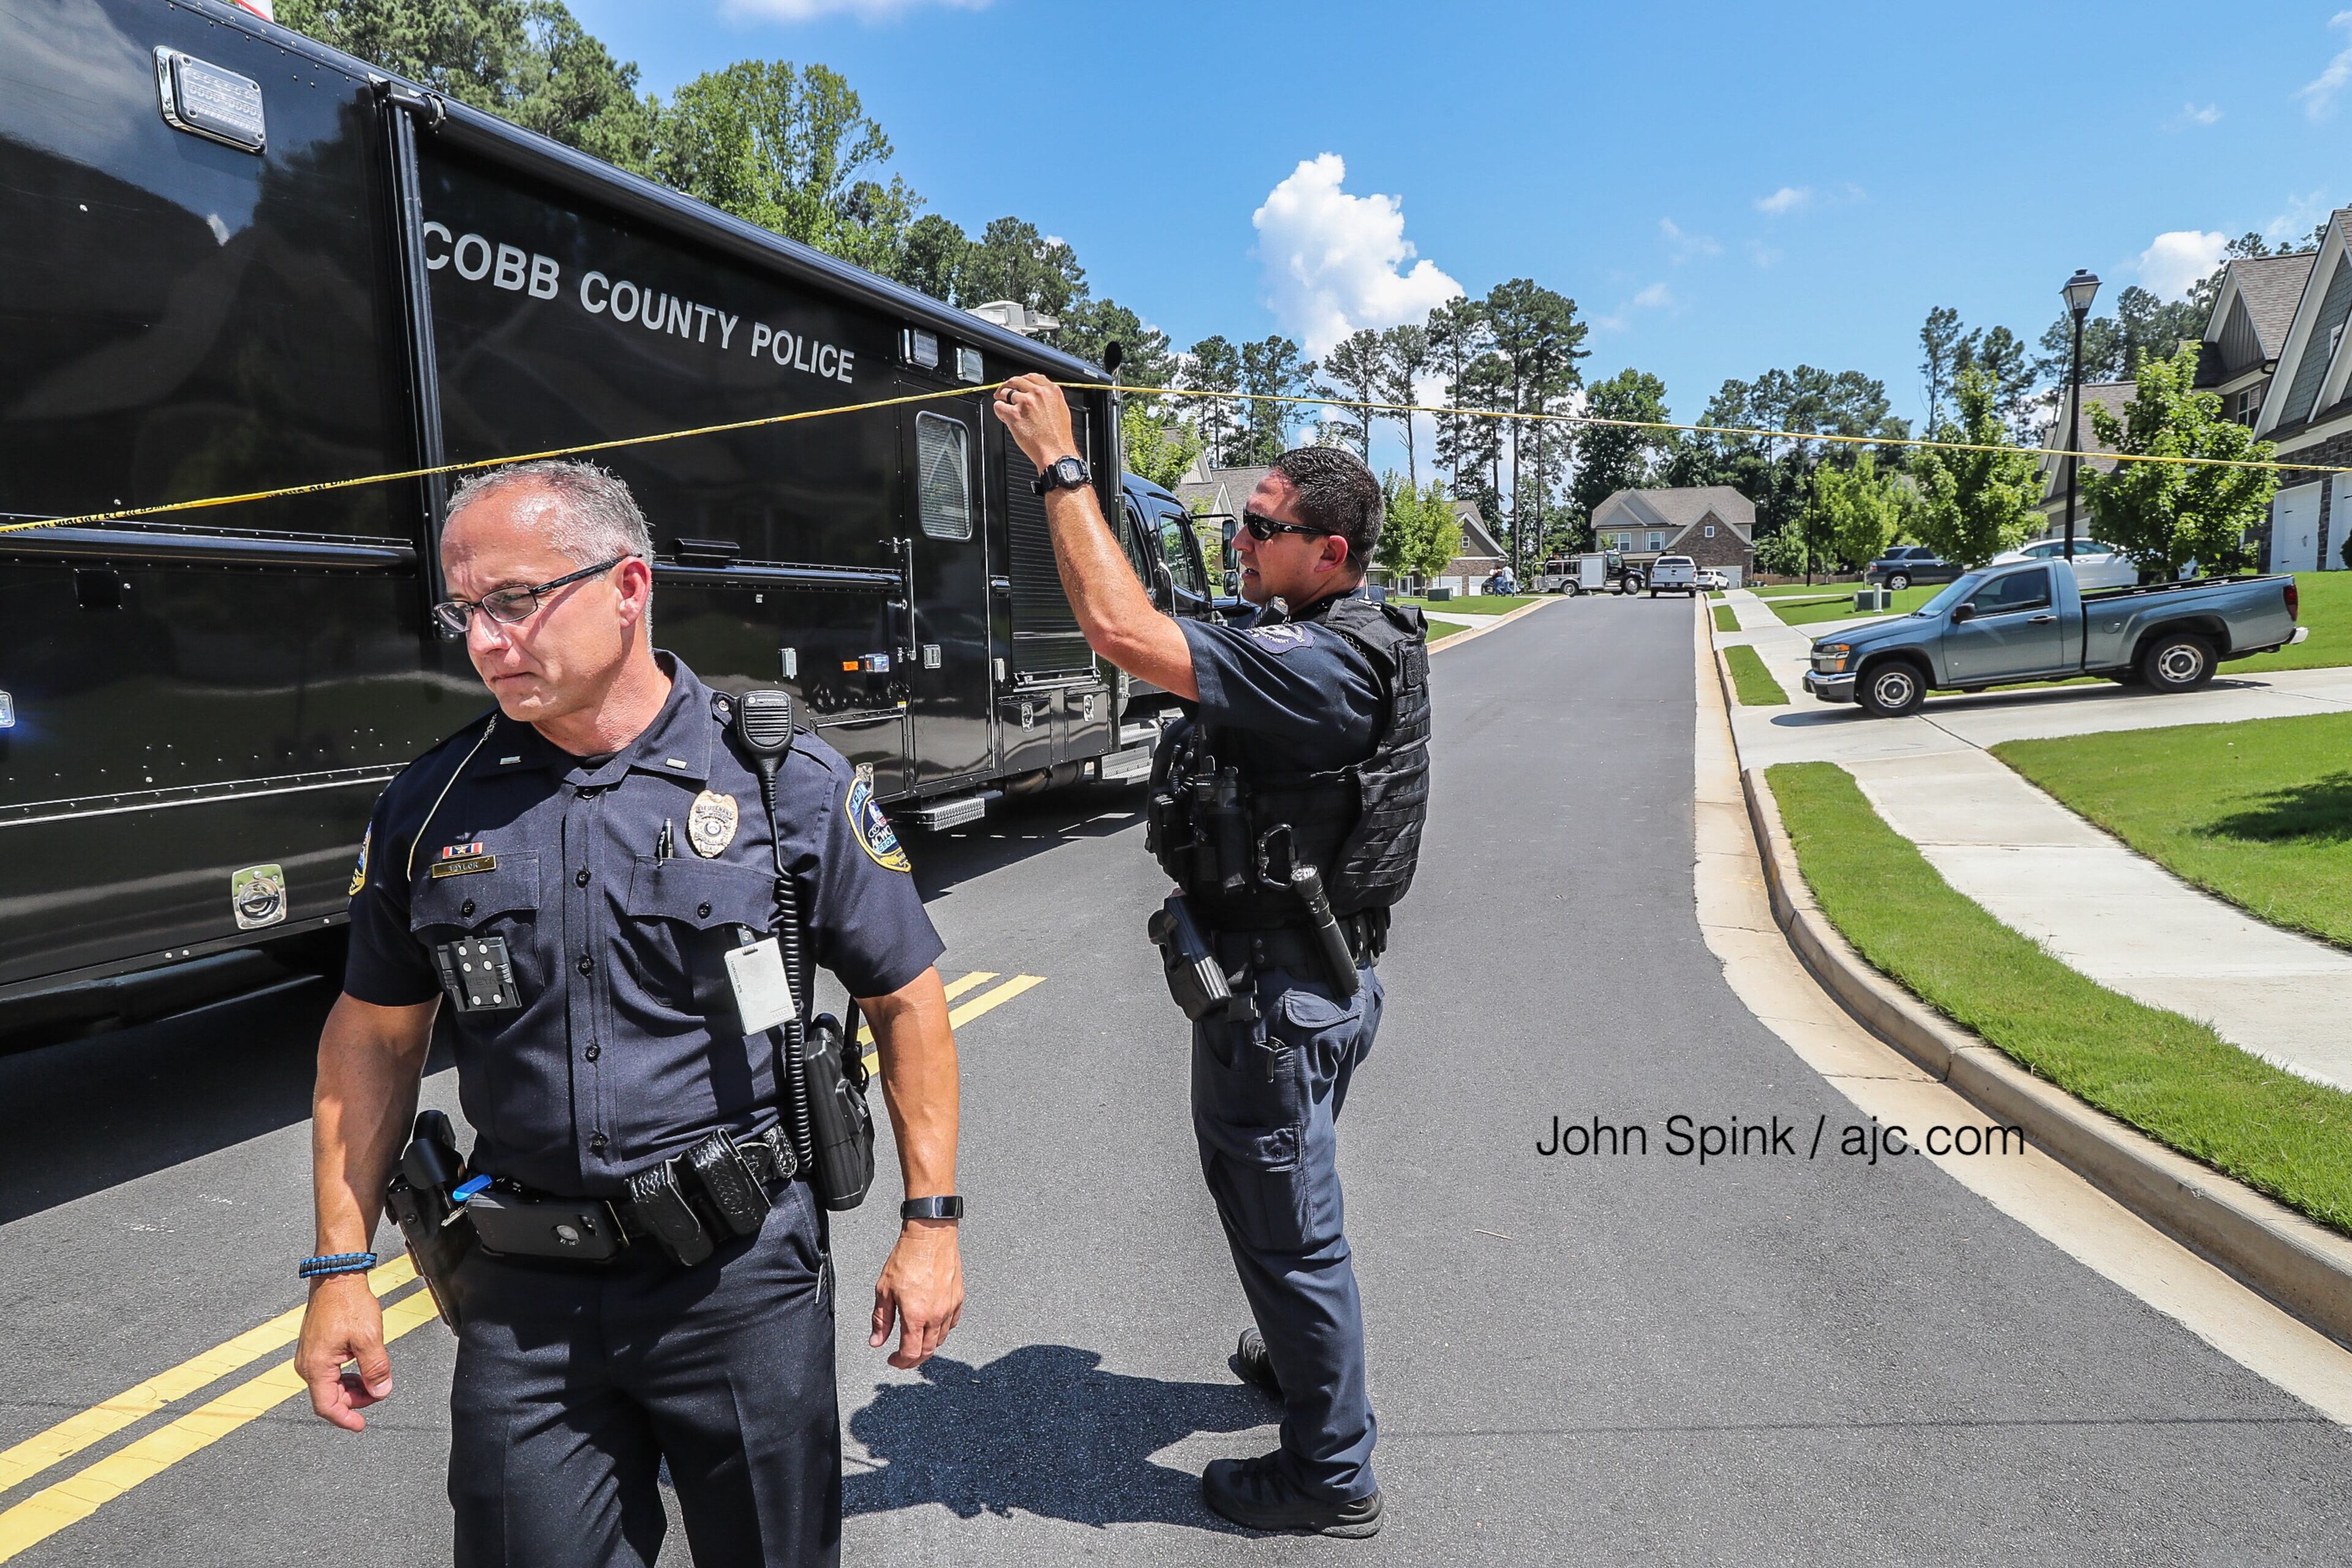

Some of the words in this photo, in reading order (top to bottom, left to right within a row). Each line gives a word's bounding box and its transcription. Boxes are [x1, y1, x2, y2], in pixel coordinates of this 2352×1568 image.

[424, 222, 560, 300] COBB
[579, 271, 739, 349] COUNTY
[751, 322, 854, 384] POLICE
[449, 862, 478, 872] TAYLOR
